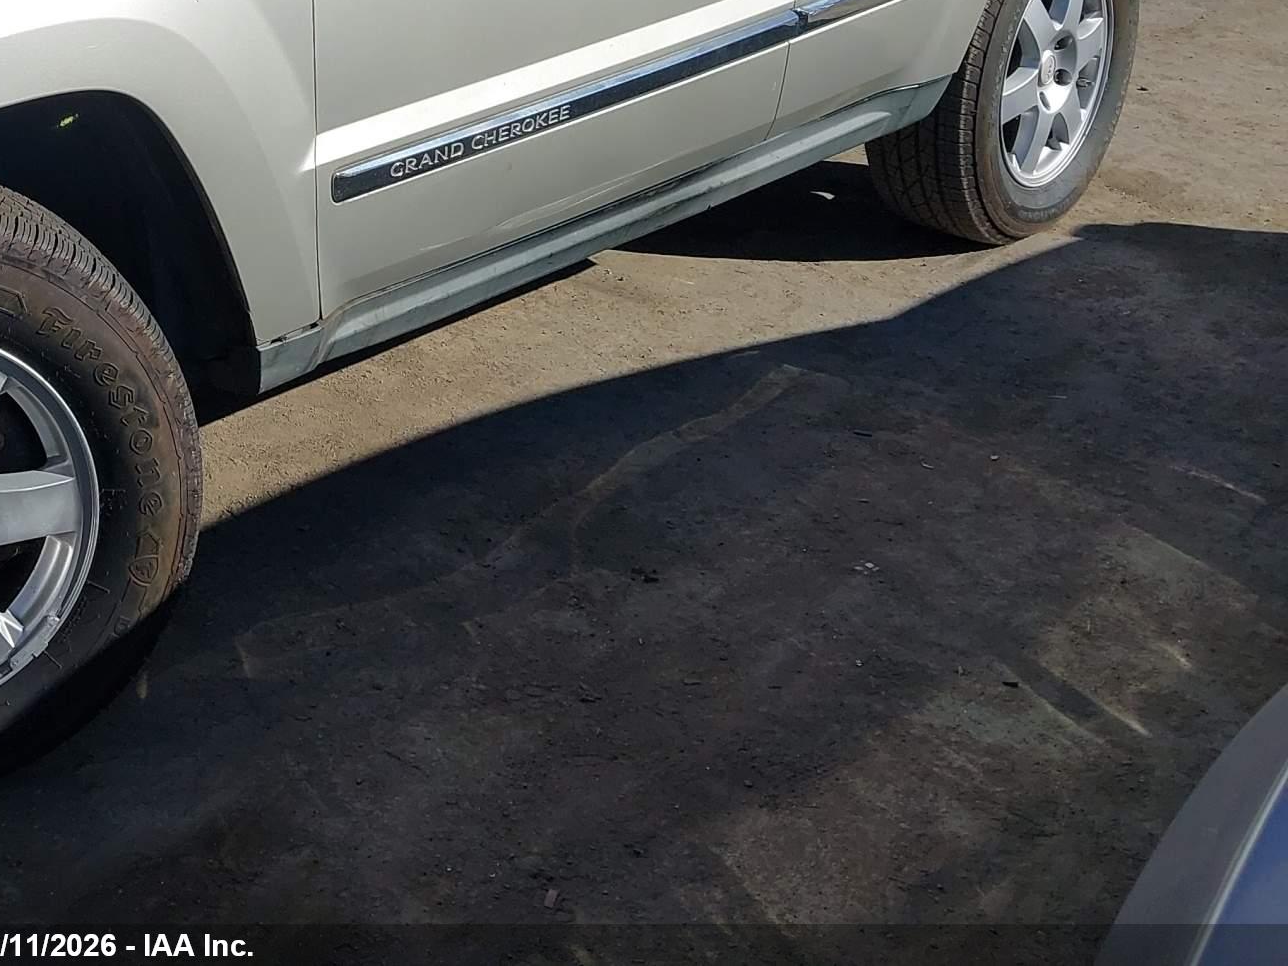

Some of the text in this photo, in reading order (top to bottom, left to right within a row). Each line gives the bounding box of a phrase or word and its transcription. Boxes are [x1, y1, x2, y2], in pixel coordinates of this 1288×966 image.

[390, 104, 571, 178] GRAND CHEROKEE
[37, 306, 162, 516] Firestone
